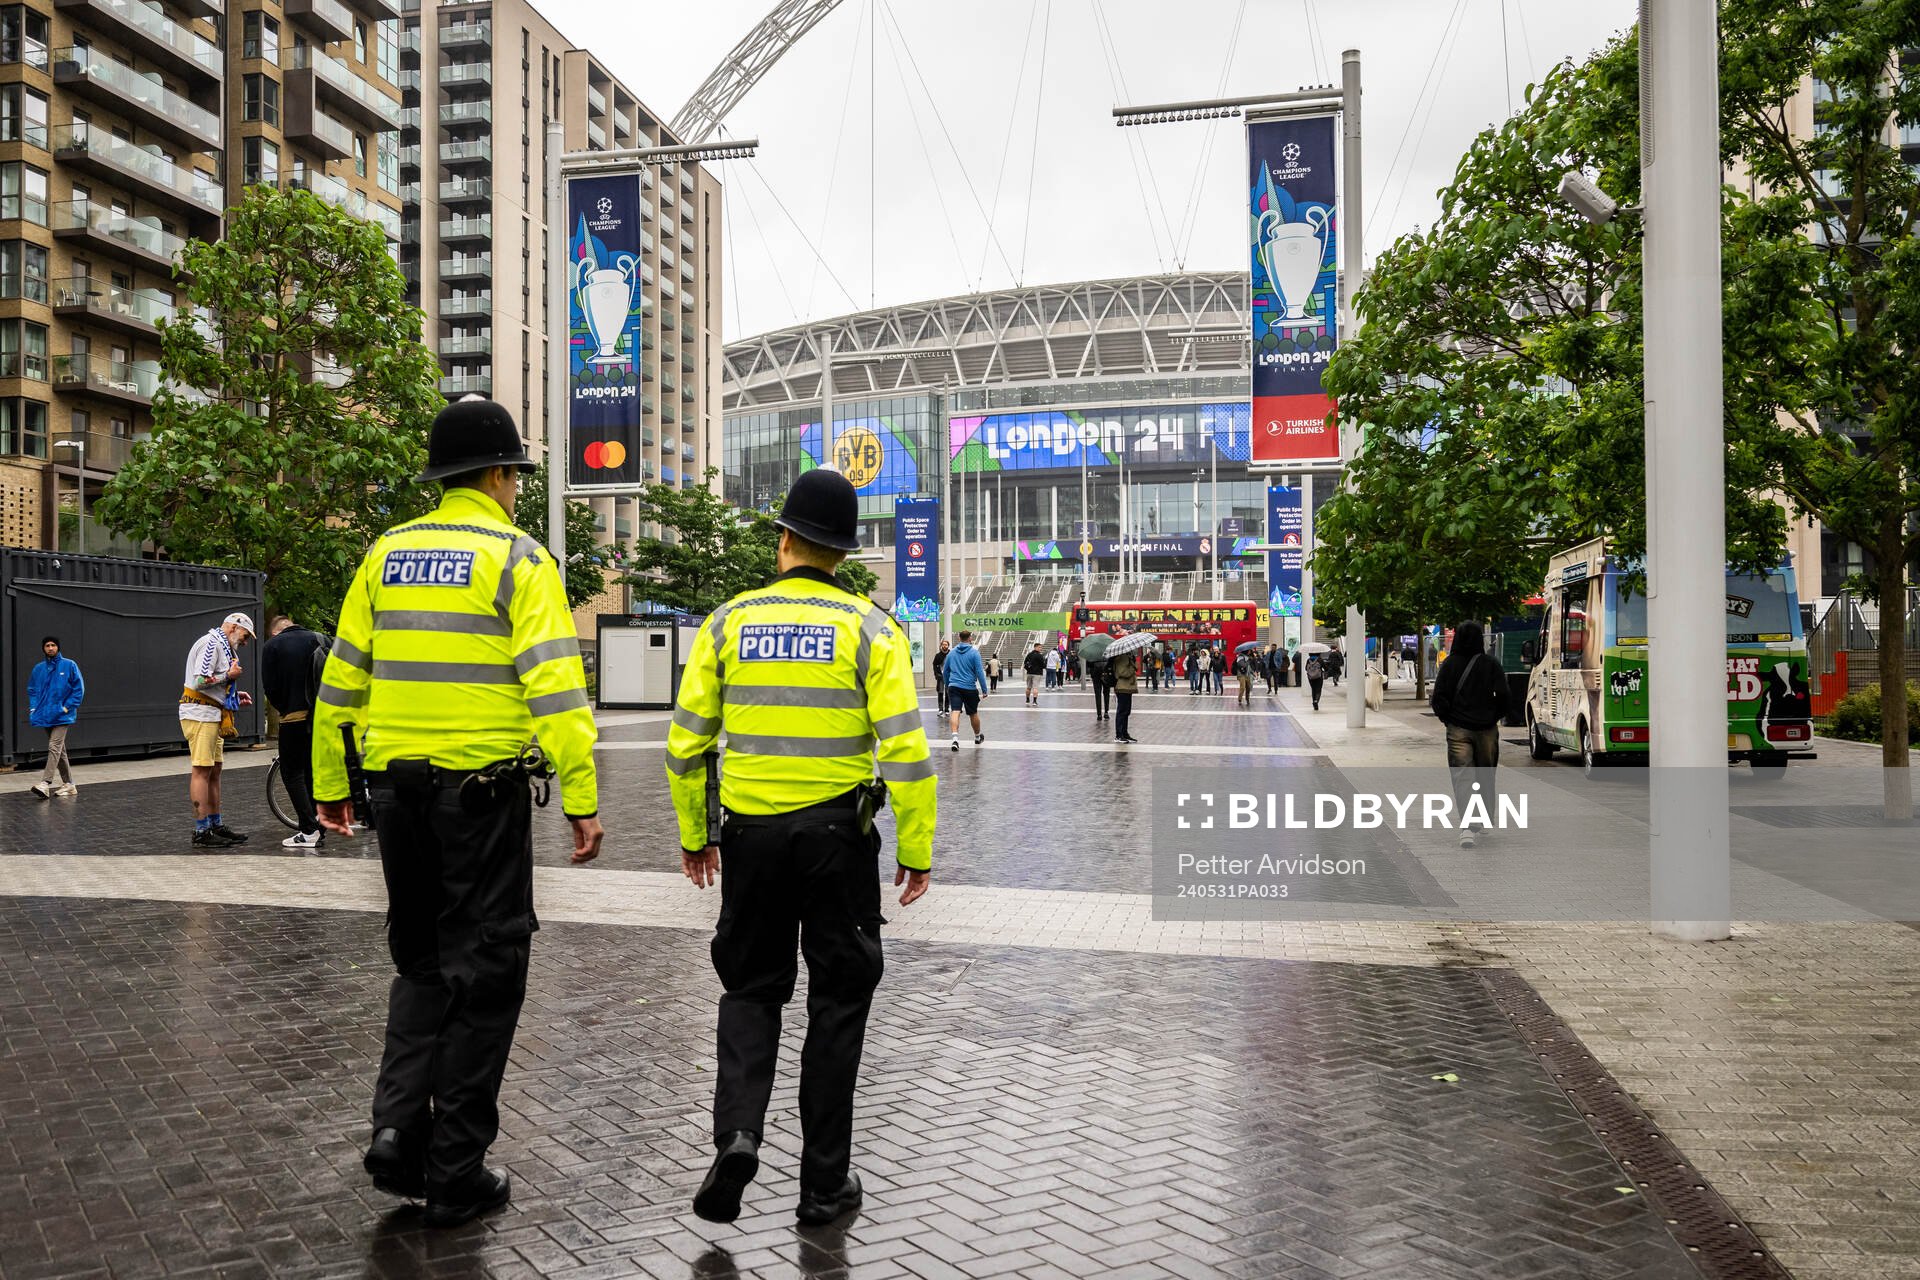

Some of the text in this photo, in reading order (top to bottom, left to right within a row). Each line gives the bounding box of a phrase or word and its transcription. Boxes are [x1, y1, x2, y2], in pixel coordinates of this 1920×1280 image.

[1272, 167, 1312, 175] CHAMPIONS
[1312, 350, 1331, 364] 24
[620, 385, 636, 397] 24
[1285, 419, 1324, 428] TURKISH
[1134, 418, 1183, 452] 24
[1200, 416, 1250, 449] FI
[1285, 426, 1325, 435] AIRLINES
[838, 433, 878, 473] BVB
[849, 468, 865, 482] 09
[1152, 543, 1183, 551] FINAL
[388, 551, 472, 561] METROPOLITAN
[384, 560, 470, 583] POLICE
[964, 617, 1024, 627] GREEN ZONE
[743, 626, 833, 636] METROPOLITAN
[741, 635, 832, 659] POLICE
[1727, 658, 1759, 673] HAT
